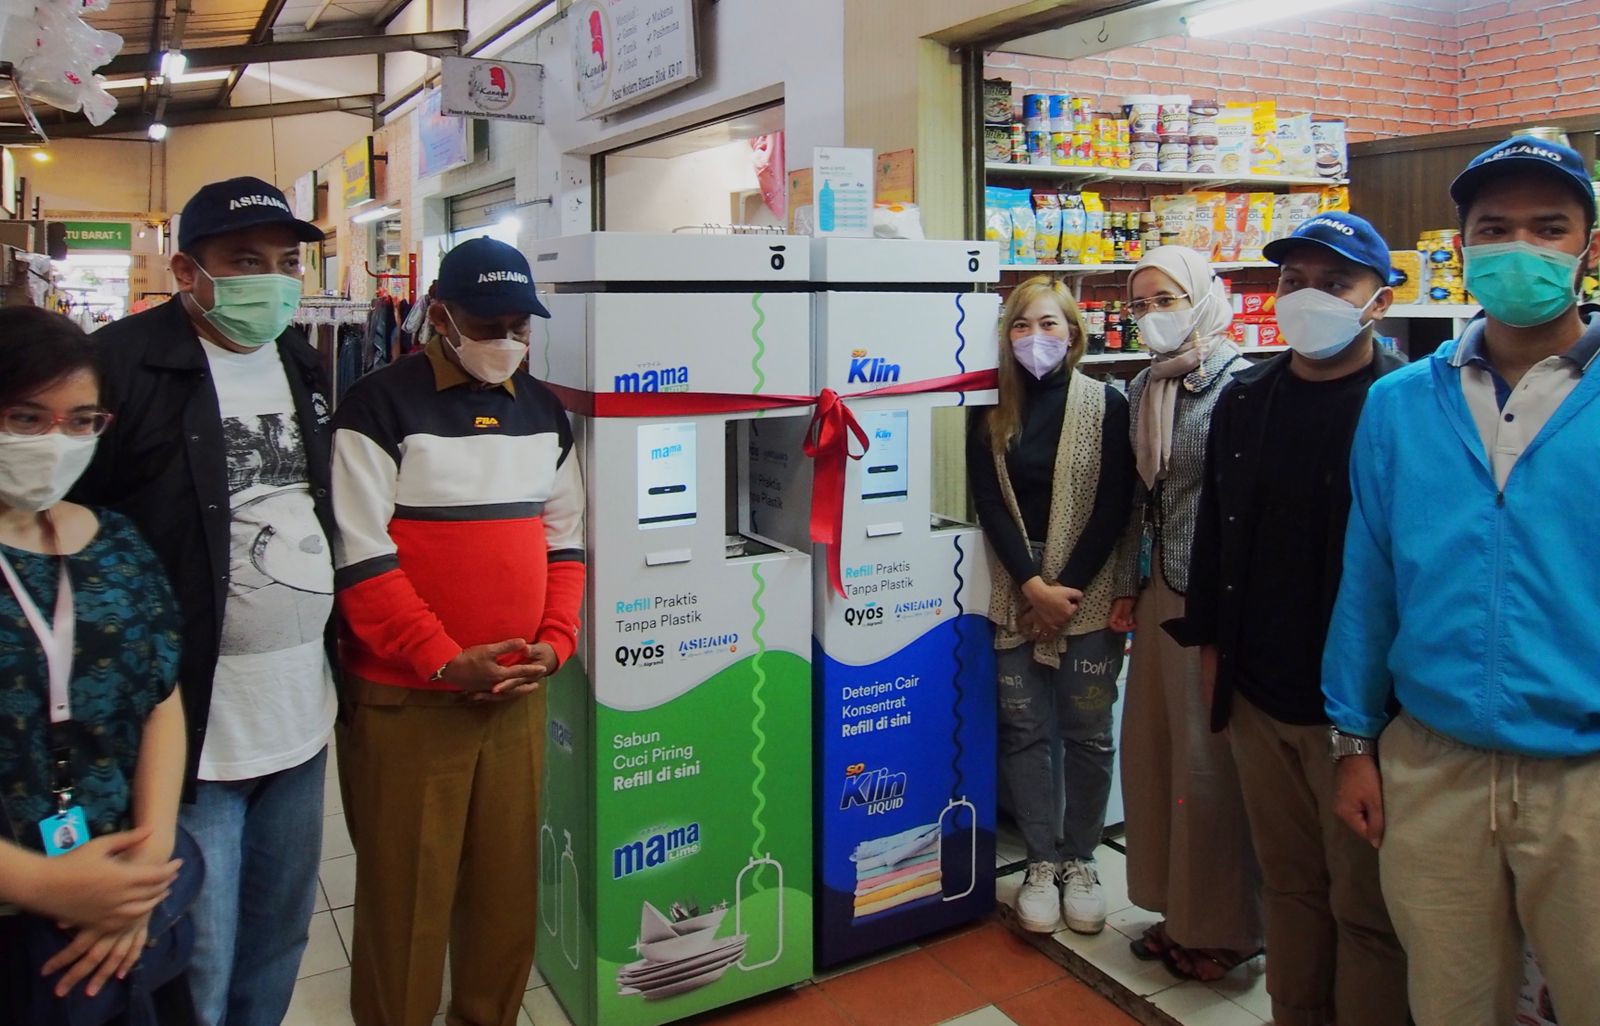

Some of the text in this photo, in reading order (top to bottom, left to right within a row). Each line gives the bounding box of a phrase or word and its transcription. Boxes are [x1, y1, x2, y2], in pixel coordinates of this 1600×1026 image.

[81, 230, 114, 240] BARAT
[116, 231, 122, 240] 1
[477, 271, 529, 284] ASEANO
[614, 366, 688, 392] mama
[848, 357, 901, 384] Klin
[475, 417, 499, 425] FILA
[651, 443, 682, 460] mama
[845, 561, 910, 579] Refill Praktis
[845, 577, 914, 596] Tanpa Plastik
[616, 593, 698, 614] Refill Praktis
[894, 598, 942, 613] ASEANO
[616, 611, 702, 633] Tanpa Plastik
[679, 633, 738, 652] ASEANO
[842, 675, 920, 701] Deterjen Cair
[842, 696, 907, 718] Konsentrat
[842, 712, 911, 737] Refill di sini
[613, 730, 661, 749] Sabun
[613, 744, 694, 770] Cuci Piring
[613, 761, 701, 791] Refill di sini
[845, 762, 865, 775] SO
[840, 767, 907, 810] Klin
[867, 797, 904, 815] LIQUID
[614, 822, 699, 879] mama
[668, 844, 699, 861] Lime
